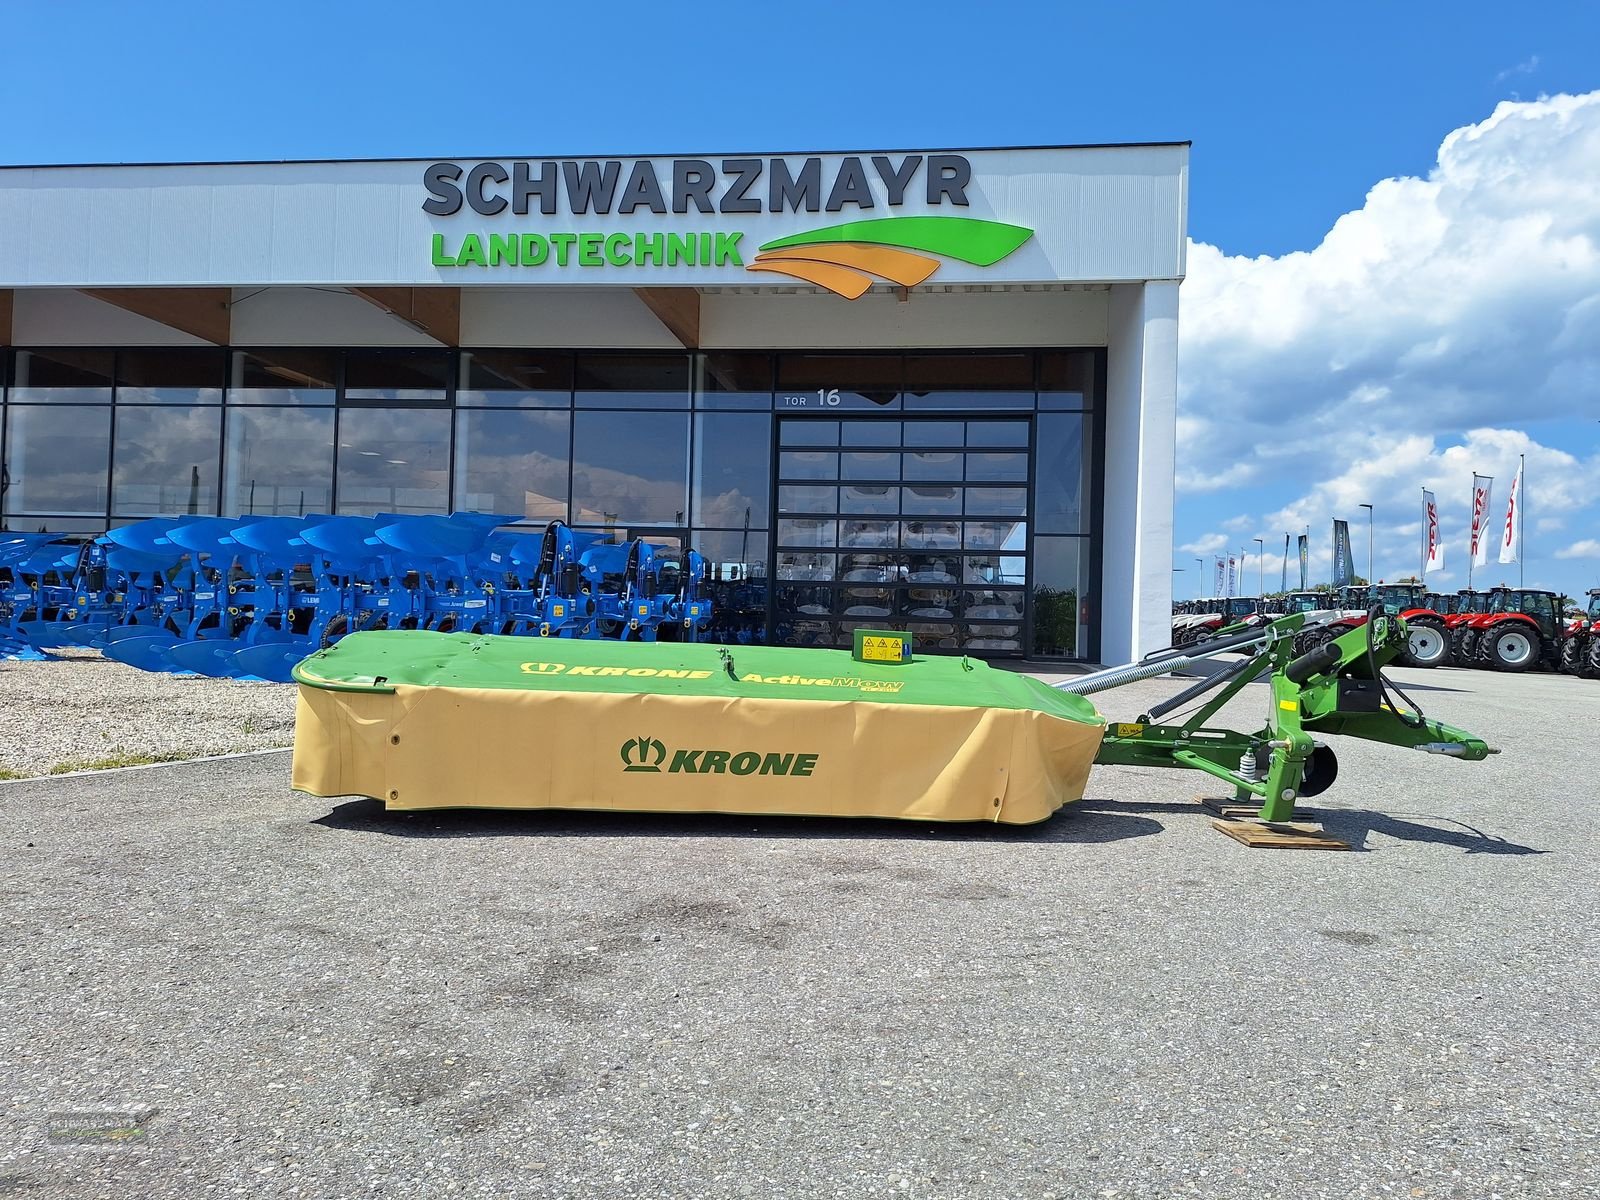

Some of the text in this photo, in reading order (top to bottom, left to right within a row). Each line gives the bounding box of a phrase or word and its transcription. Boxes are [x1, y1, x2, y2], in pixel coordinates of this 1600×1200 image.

[421, 155, 971, 216] SCHWARZMAYR
[432, 232, 744, 267] LANDTECHNIK
[784, 388, 840, 406] TOR 16
[565, 665, 714, 679] KRONE
[668, 750, 819, 777] KRONE
